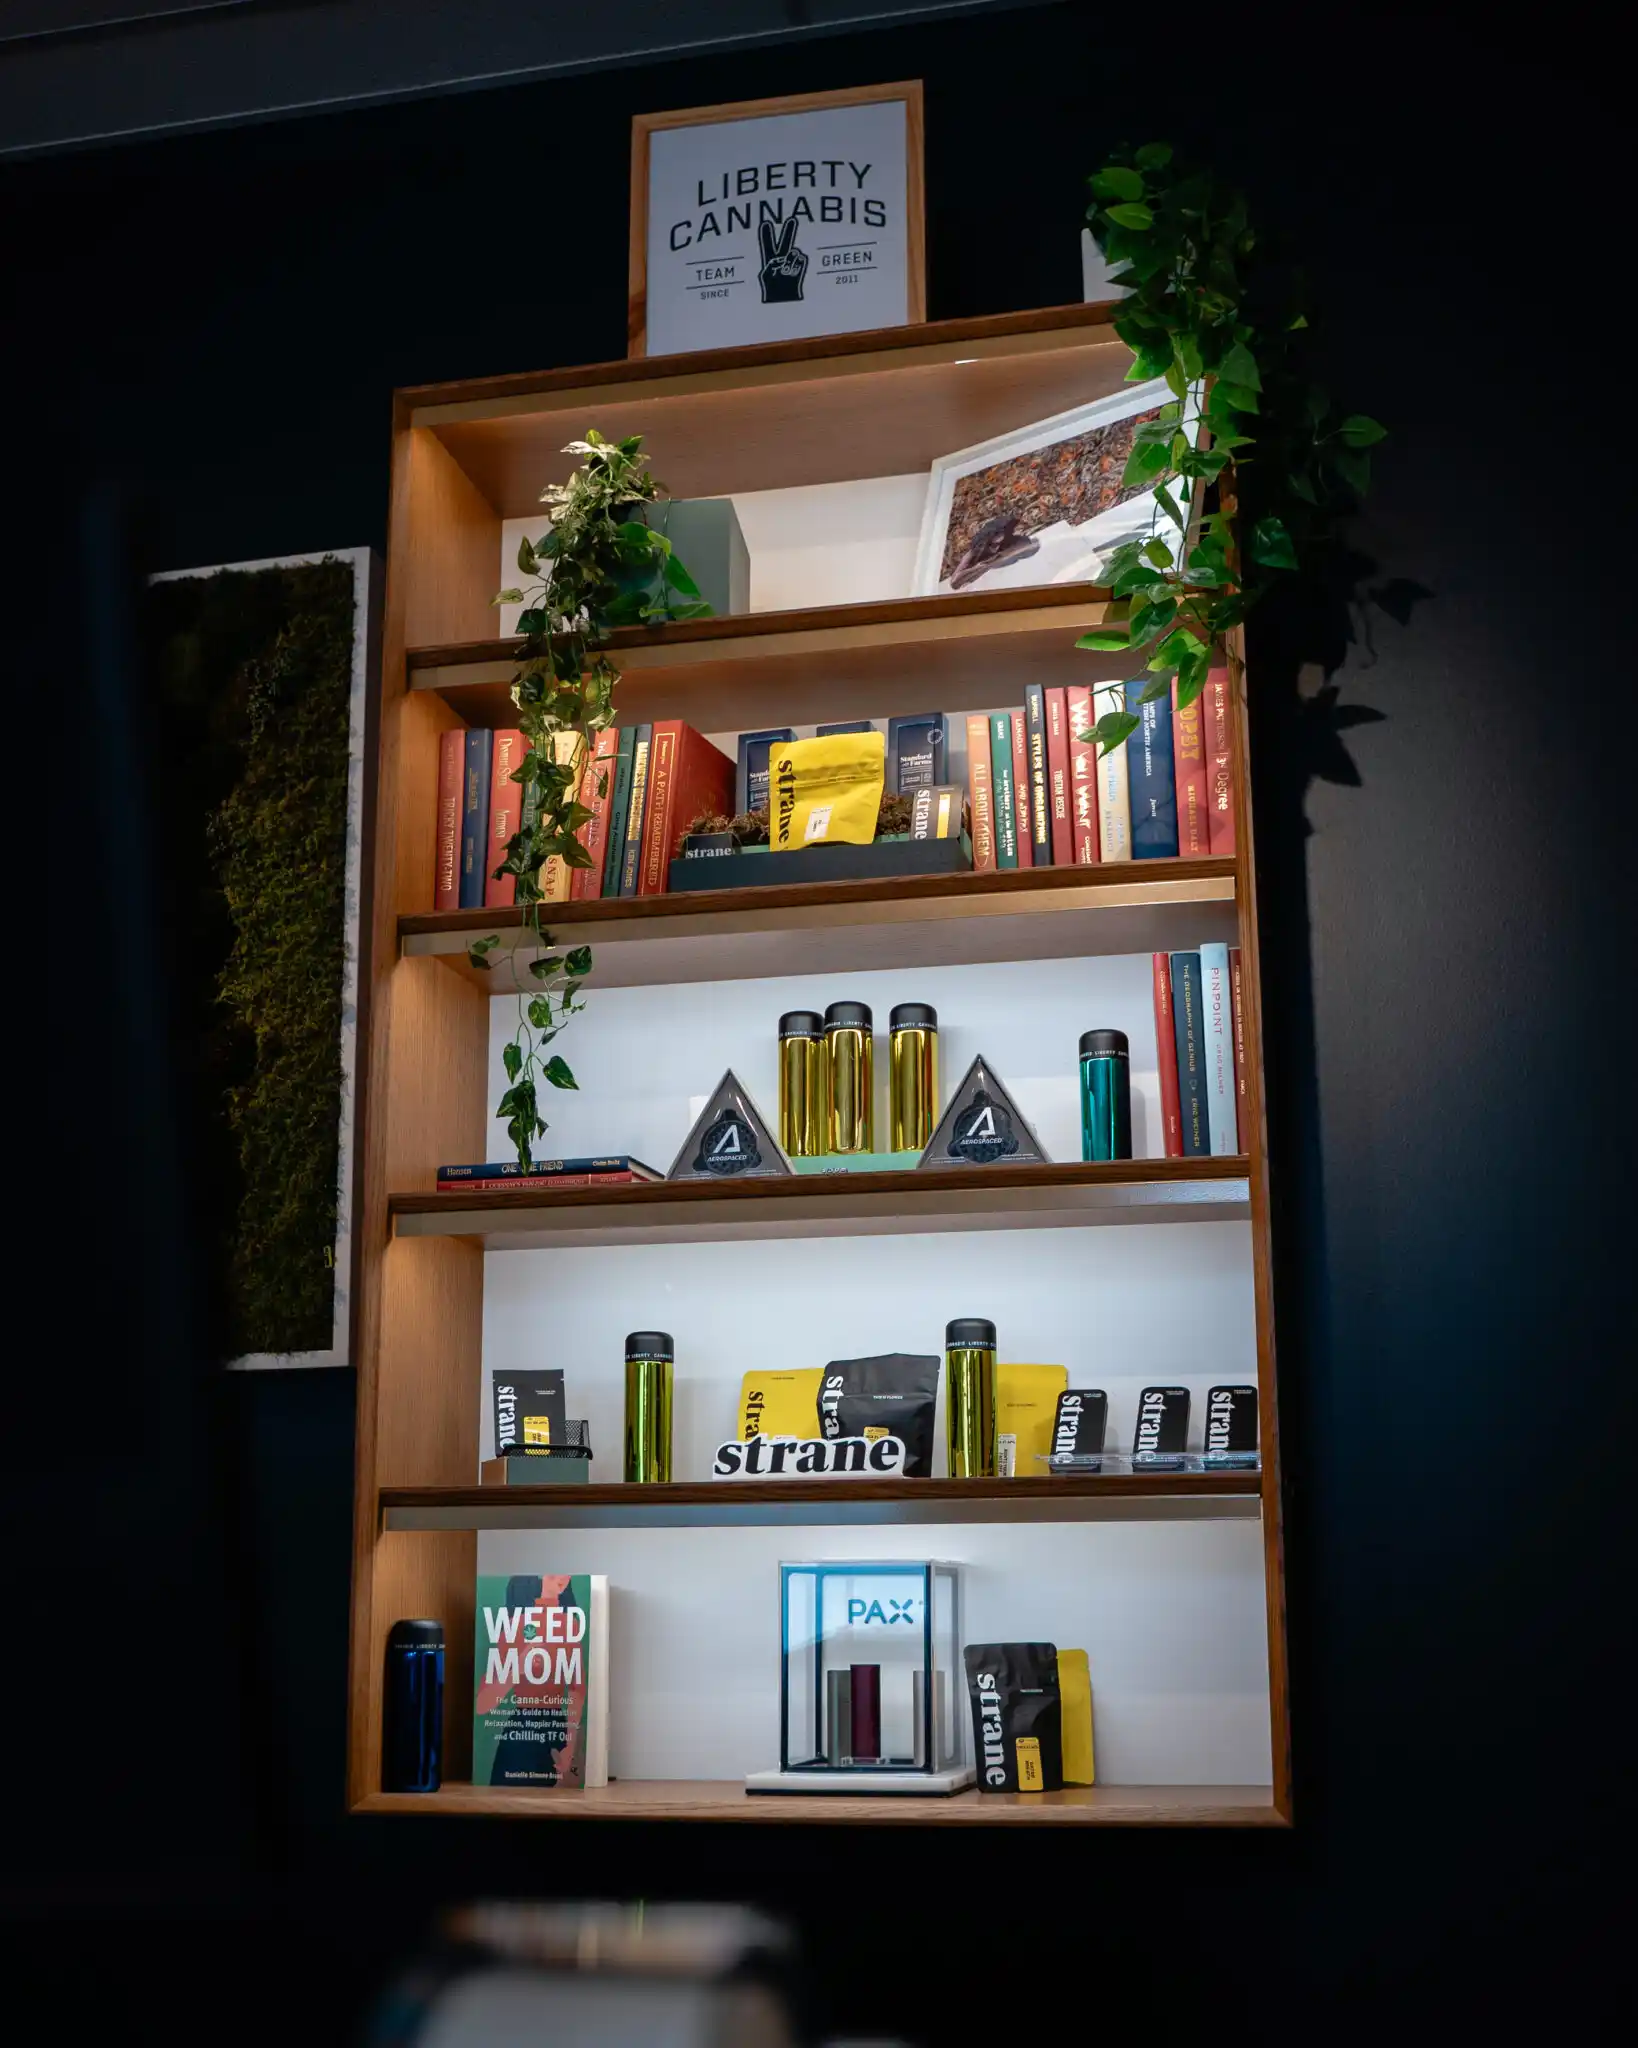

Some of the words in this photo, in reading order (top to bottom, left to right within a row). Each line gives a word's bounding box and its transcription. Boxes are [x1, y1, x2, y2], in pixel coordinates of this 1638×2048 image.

[698, 160, 873, 208] LIBERTY
[669, 196, 887, 252] CANNABIS
[696, 266, 735, 282] TEAM
[822, 251, 873, 267] GREEN
[700, 288, 730, 300] SINCE
[835, 275, 859, 285] 2011
[1215, 683, 1224, 707] JAMES
[1143, 722, 1151, 746] NORTH
[1216, 708, 1226, 750] PATTERSON
[900, 753, 932, 762] Standard
[1032, 733, 1043, 769] STYLES
[1144, 747, 1152, 777] AMERICA
[657, 770, 667, 778] A
[750, 771, 770, 779] Stand
[973, 764, 986, 785] ALL
[1033, 771, 1043, 784] OF
[1053, 769, 1064, 795] TIBETAN
[655, 781, 666, 809] PATH
[777, 760, 799, 844] strane
[974, 787, 988, 822] ABOUT
[1075, 783, 1093, 829] WANT
[1187, 784, 1198, 826] MICHAEL
[1215, 772, 1229, 810] Degree
[443, 797, 456, 829] TRICKY
[914, 789, 933, 840] strane
[1034, 785, 1046, 844] ORGANIZING
[1055, 796, 1065, 819] RESCUE
[648, 813, 663, 887] REMEMBERED
[686, 846, 732, 859] strane
[977, 826, 990, 856] THEM
[1189, 828, 1199, 853] DALY
[440, 830, 454, 891] TWENTY-TWO
[546, 857, 557, 896] SNAP
[1184, 981, 1192, 1027] GEOGRAPHY
[1211, 967, 1222, 1035] PINPOINT
[1187, 1030, 1194, 1040] OF
[1188, 1042, 1196, 1072] GENIUS
[1191, 1098, 1199, 1116] ERIC
[960, 1136, 1003, 1145] AEROSPACED
[1193, 1117, 1201, 1147] WEINER
[447, 1167, 472, 1176] Hansen
[501, 1163, 517, 1174] ONE
[540, 1160, 563, 1172] FRIEND
[707, 1154, 747, 1162] AEROSPACED
[744, 1391, 765, 1441] stra
[822, 1375, 845, 1440] stra
[1055, 1395, 1084, 1464] strane
[1135, 1392, 1168, 1462] strane
[1208, 1391, 1236, 1461] strane
[714, 1435, 900, 1475] strane
[483, 1606, 586, 1643] WEED
[848, 1599, 914, 1624] PAX
[485, 1648, 582, 1685] MOM
[489, 1708, 521, 1717] Woman's
[522, 1708, 542, 1717] Guide
[496, 1696, 508, 1704] The
[510, 1694, 574, 1705] Canna-Curious
[484, 1719, 524, 1728] Relaxation,
[525, 1720, 551, 1729] Happier
[494, 1732, 508, 1740] and
[509, 1730, 546, 1743] Chilling
[547, 1731, 558, 1741] TF
[559, 1732, 572, 1741] Out
[976, 1672, 1006, 1786] strane
[504, 1771, 528, 1779] Danielle
[529, 1772, 548, 1780] Simone
